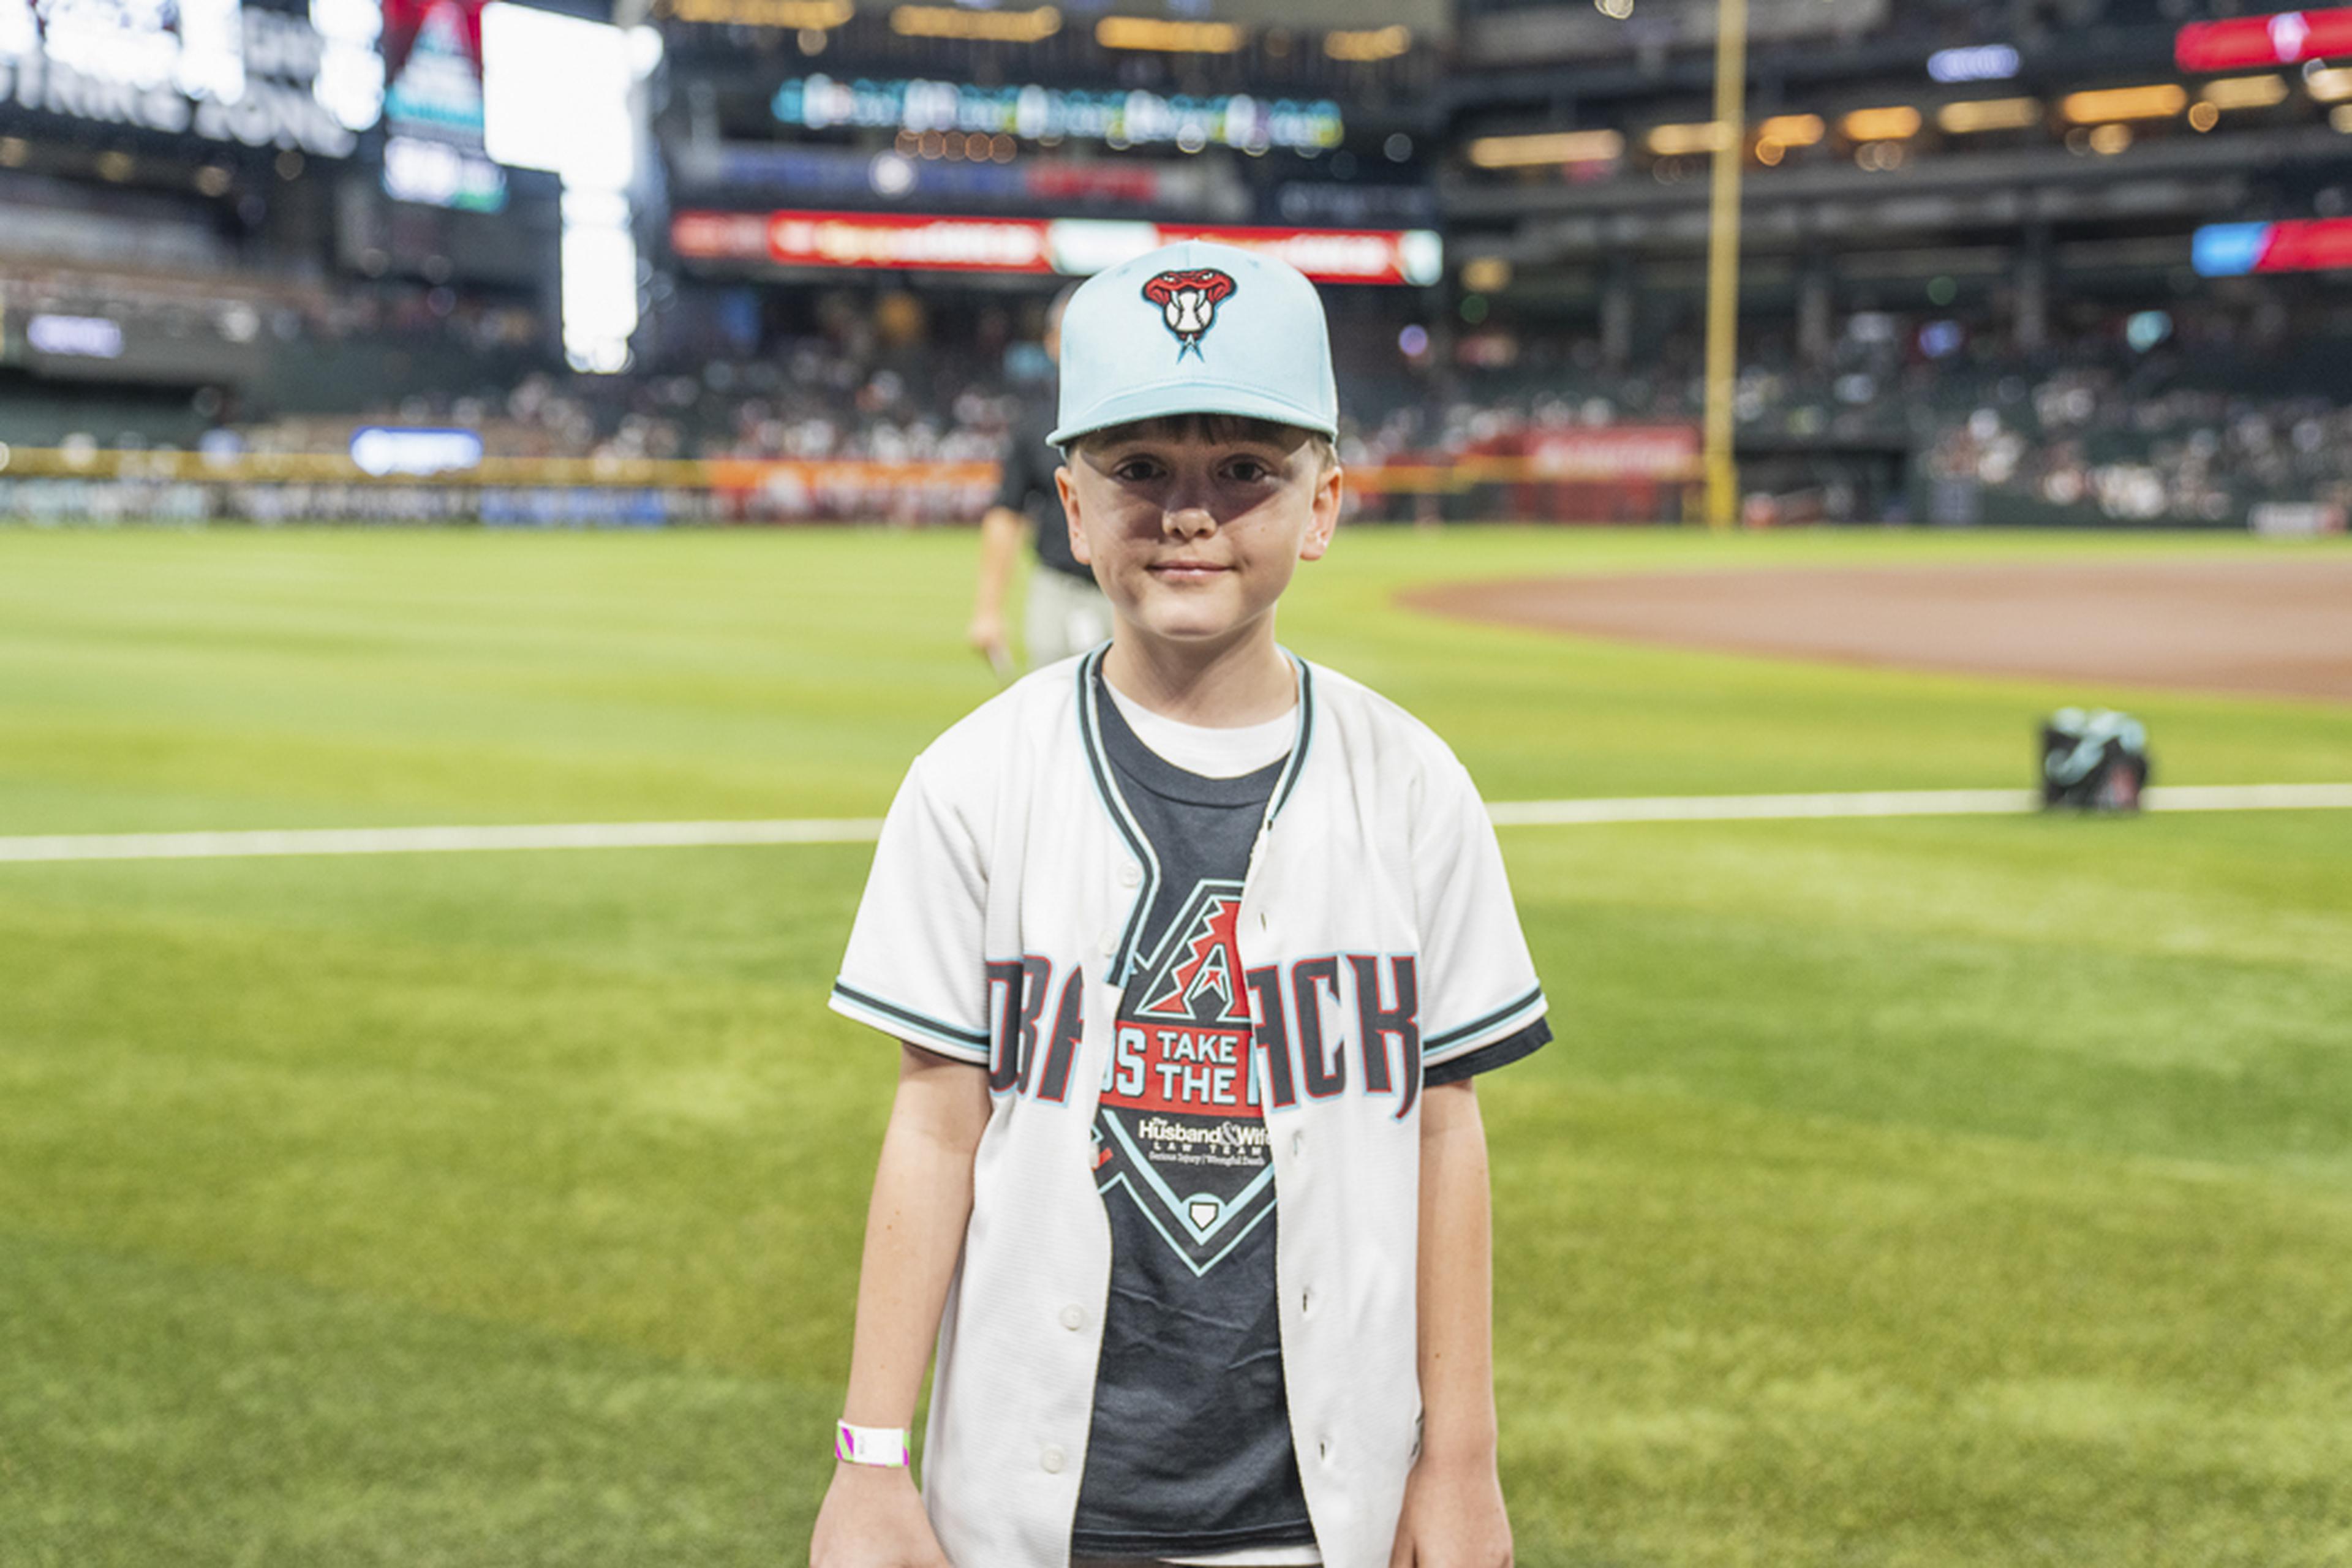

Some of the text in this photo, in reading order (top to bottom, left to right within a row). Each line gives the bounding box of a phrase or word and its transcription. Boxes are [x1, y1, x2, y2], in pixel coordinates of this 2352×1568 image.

[1156, 1031, 1238, 1065] TAKE
[1155, 1063, 1237, 1106] THE
[1153, 1141, 1262, 1156] LAW TEAM
